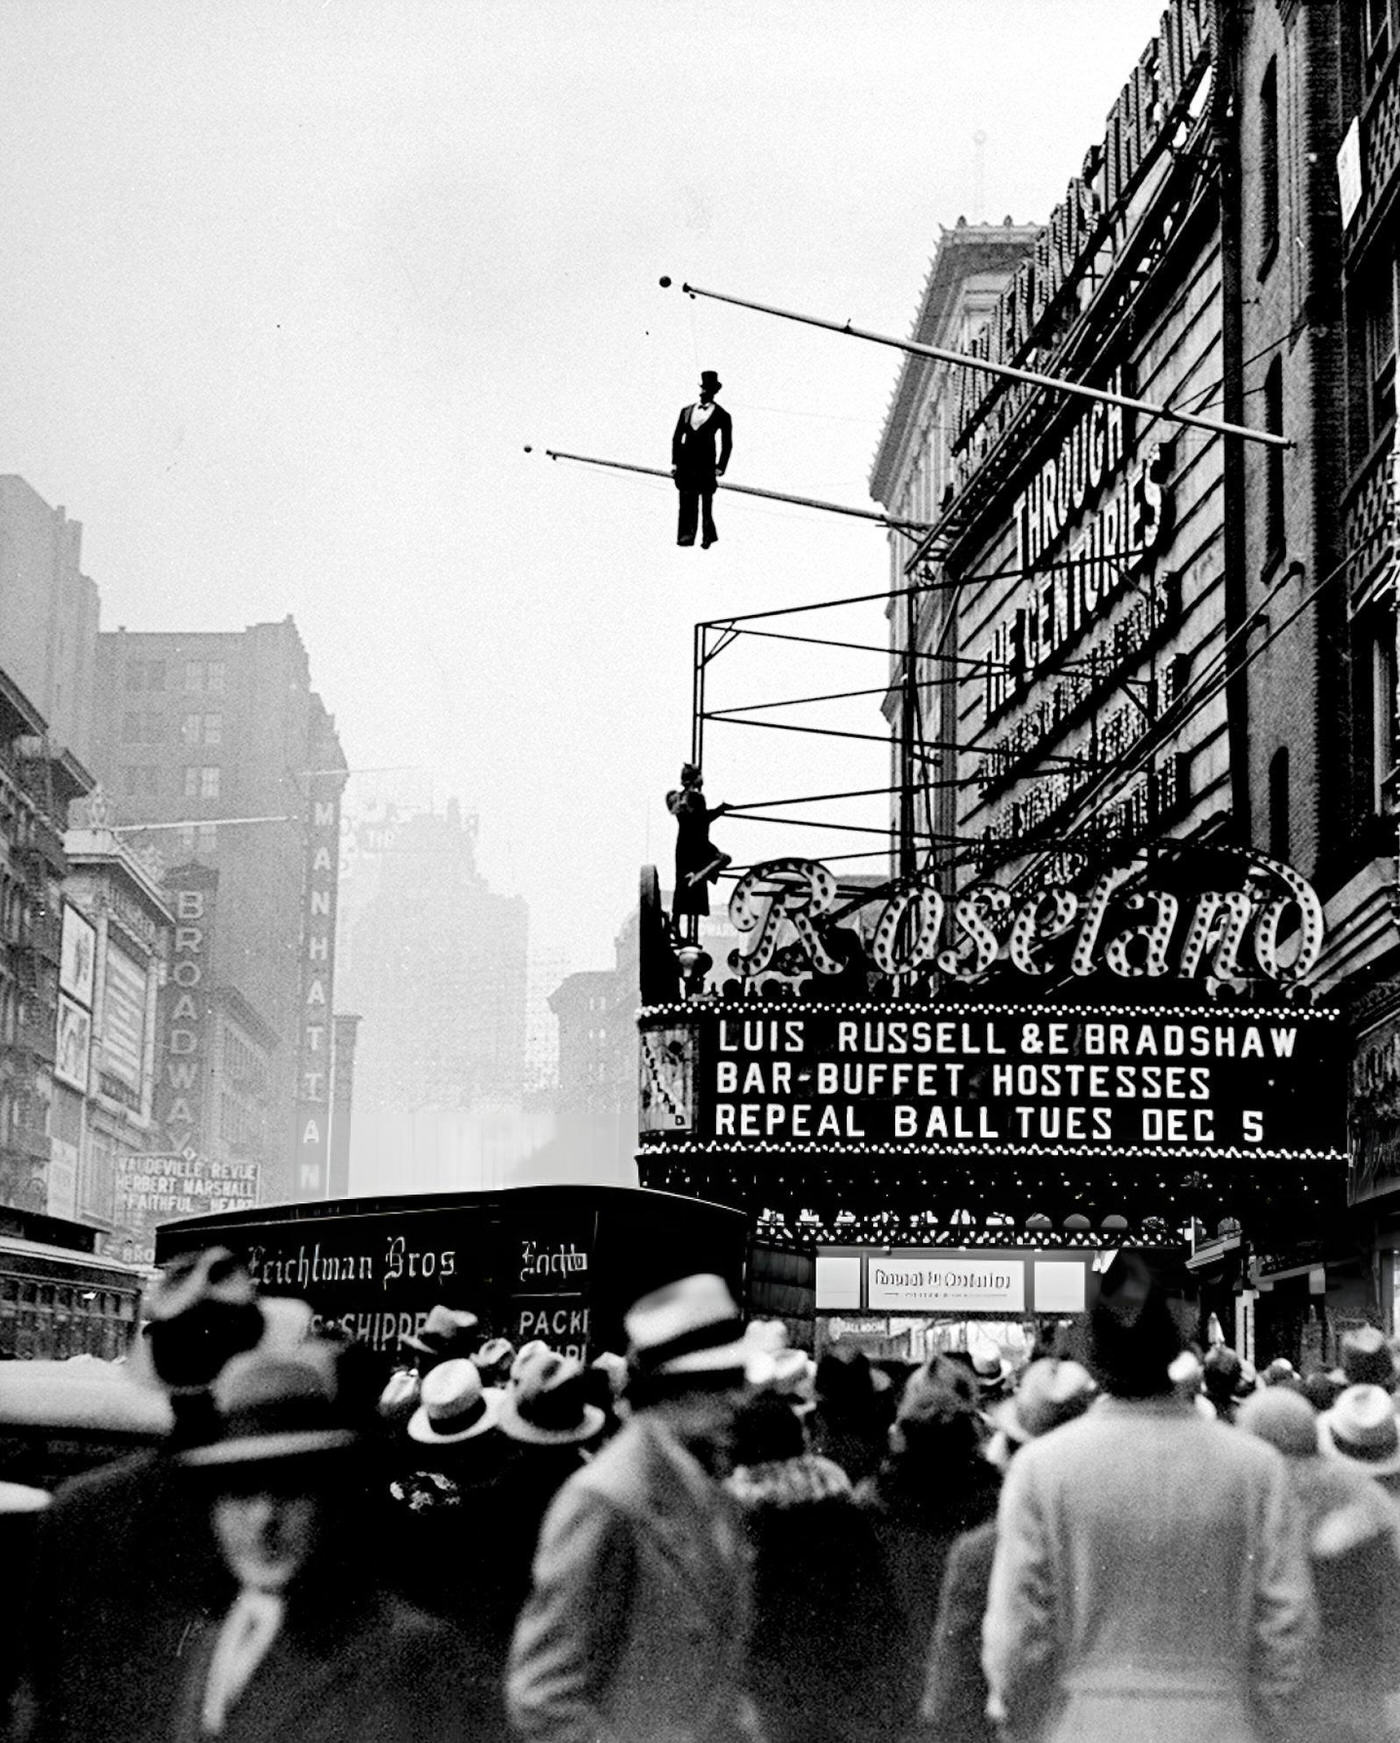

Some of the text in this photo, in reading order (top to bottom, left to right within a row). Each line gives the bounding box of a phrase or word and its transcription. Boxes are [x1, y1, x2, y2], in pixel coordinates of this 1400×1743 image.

[1014, 364, 1124, 571] THROUGH
[727, 850, 1323, 980] Roseland
[166, 890, 203, 1152] BROADWAY
[719, 1020, 804, 1052] LUIS
[839, 1021, 1006, 1054] RUSSELL
[1085, 1023, 1297, 1058] BRADSHAW
[717, 1061, 1210, 1100] BAR-BUFFET HOSTESSES
[716, 1104, 1263, 1142] REPEAL BALL TUES DEC 5
[118, 1173, 252, 1197] HERBERT MARSHALL
[119, 1158, 256, 1179] VAUDEVILLE REVUE
